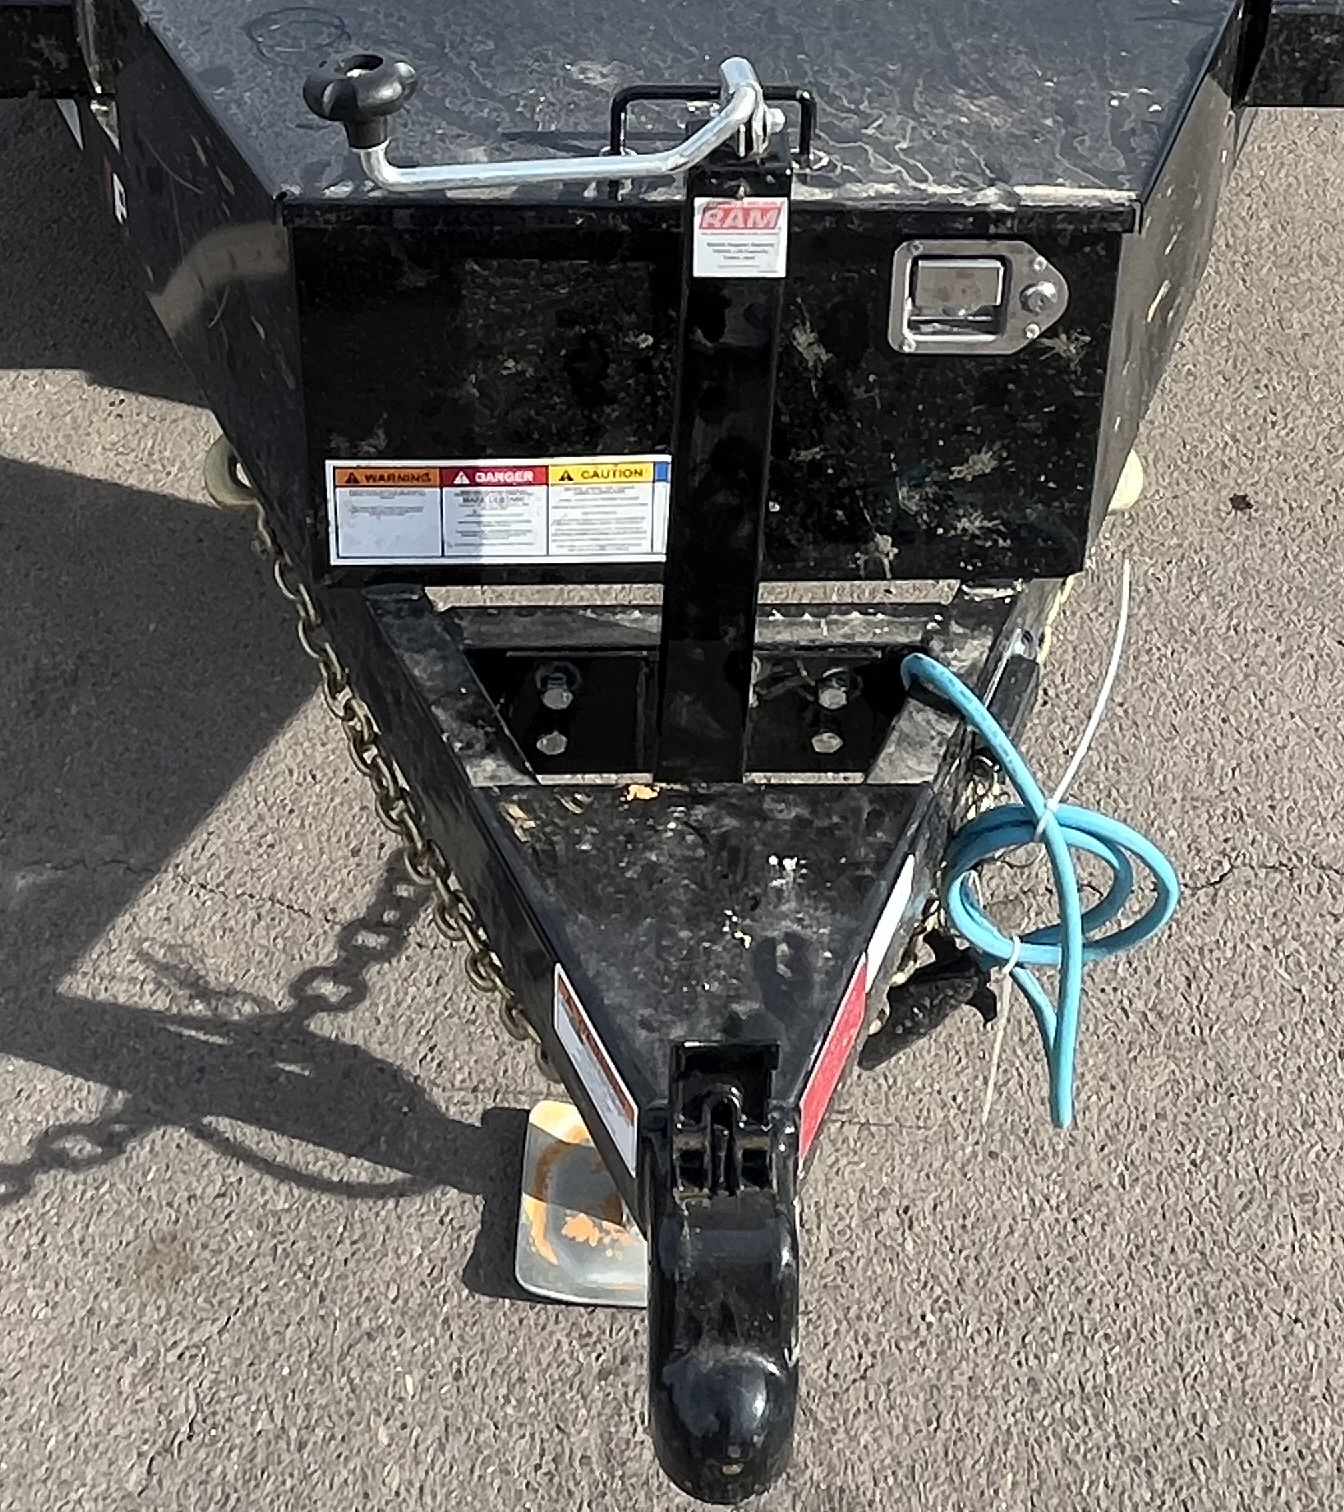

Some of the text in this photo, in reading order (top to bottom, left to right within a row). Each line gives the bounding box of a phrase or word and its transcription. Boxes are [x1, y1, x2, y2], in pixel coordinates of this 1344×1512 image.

[702, 207, 779, 228] RAM
[364, 472, 432, 484] WARNING
[474, 470, 534, 483] DANGER
[580, 468, 644, 480] CAUTION
